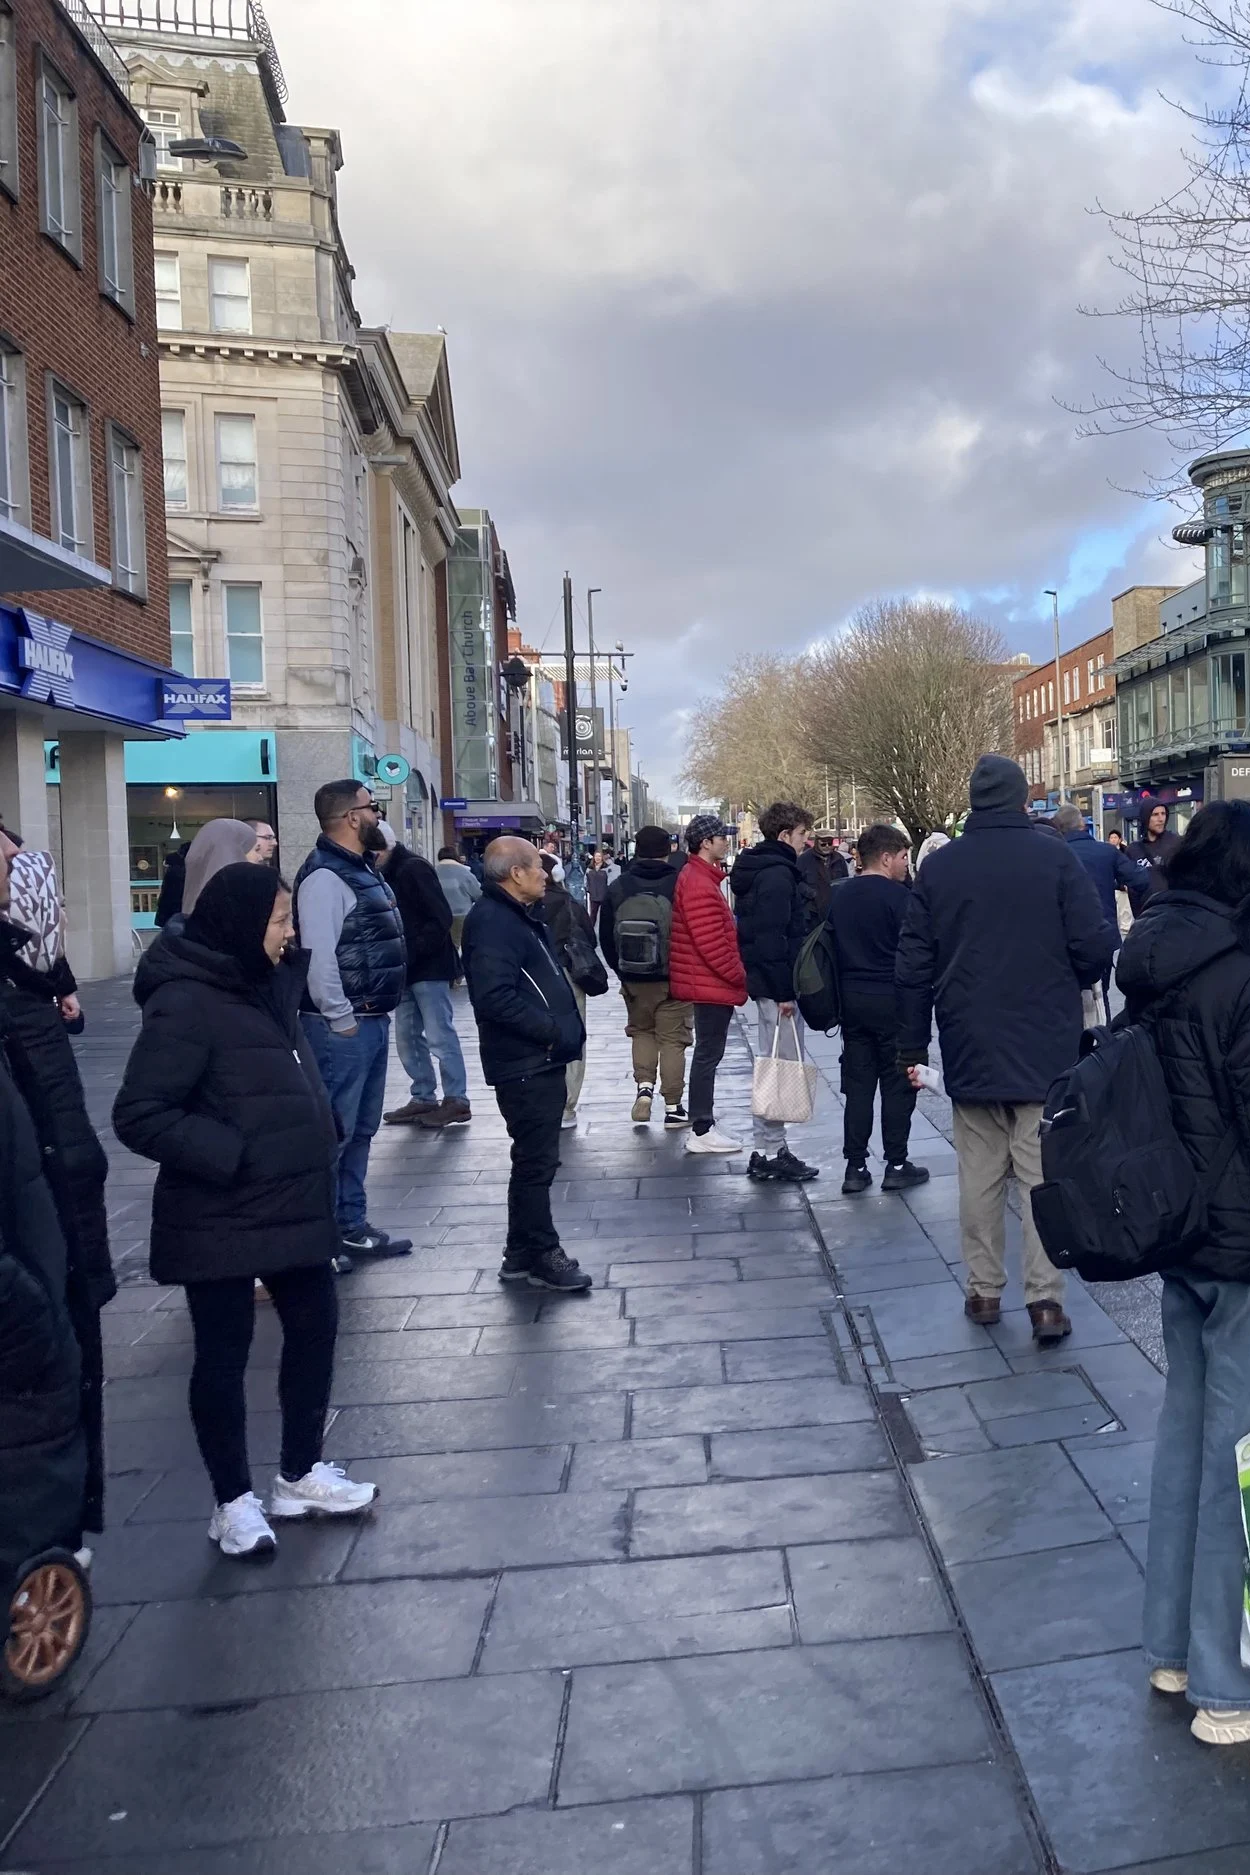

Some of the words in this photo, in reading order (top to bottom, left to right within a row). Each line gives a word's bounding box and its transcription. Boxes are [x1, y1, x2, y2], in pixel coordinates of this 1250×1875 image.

[461, 610, 474, 658] Church
[24, 639, 75, 681] HALIFAX
[464, 661, 476, 683] Bar
[164, 693, 227, 704] HALIFAX
[465, 686, 477, 727] Above
